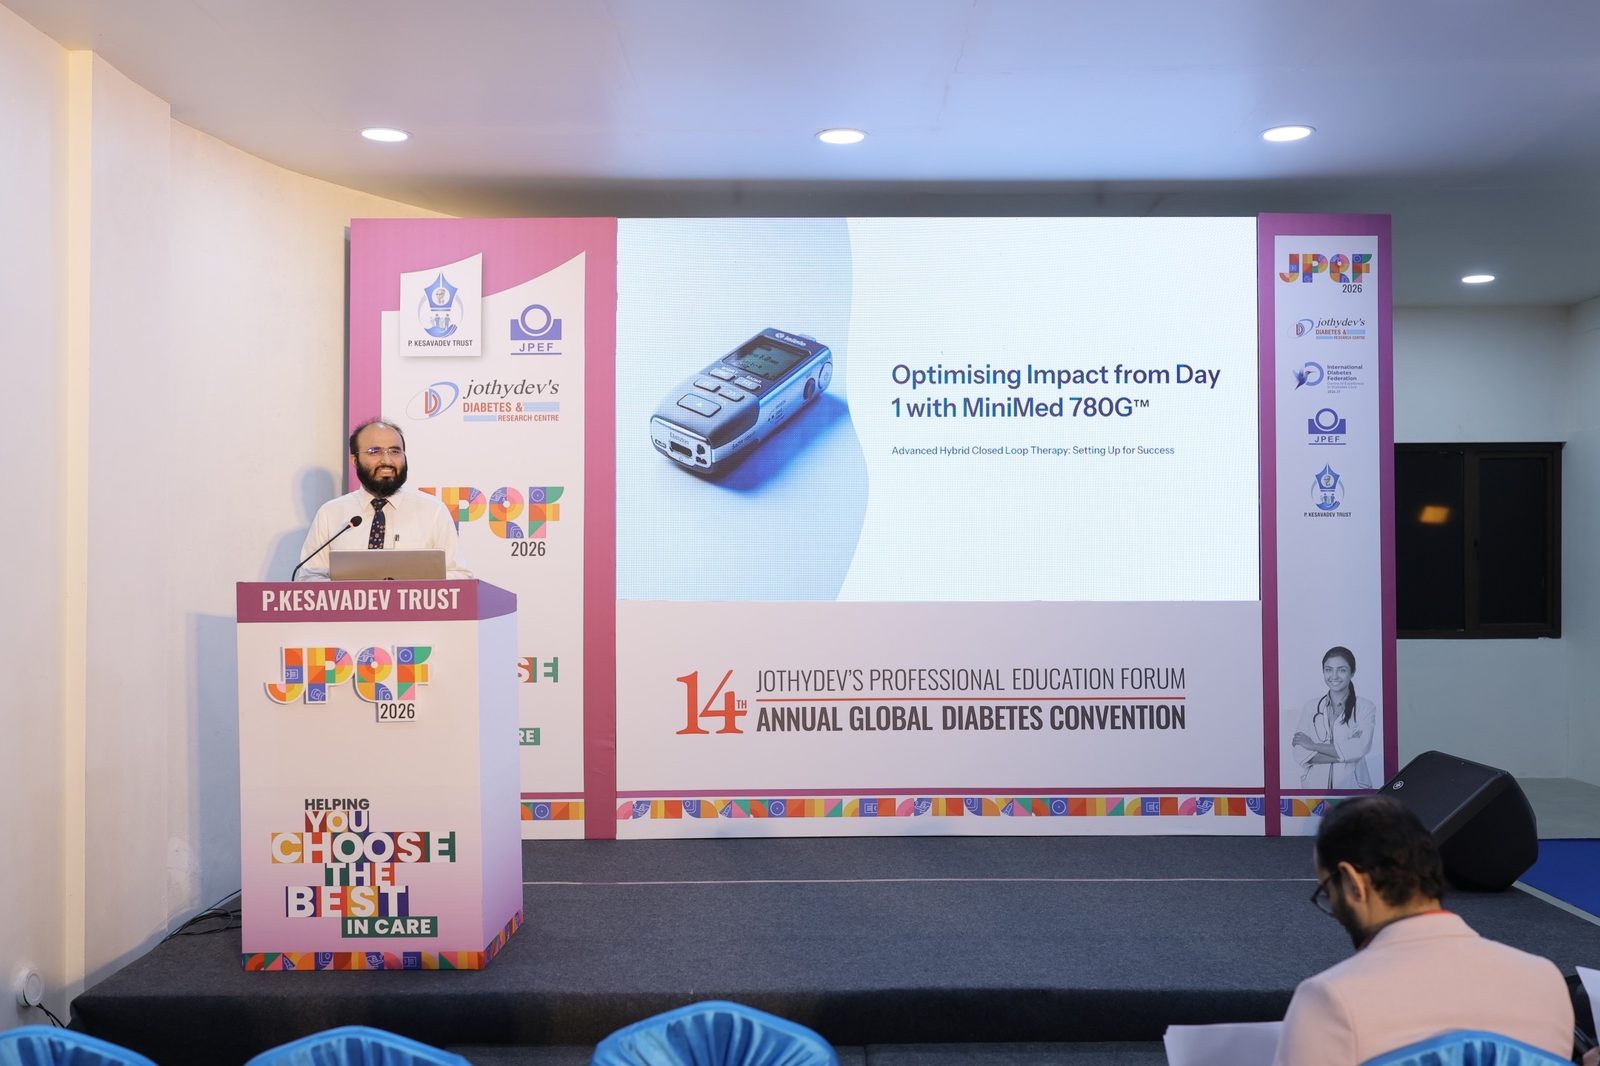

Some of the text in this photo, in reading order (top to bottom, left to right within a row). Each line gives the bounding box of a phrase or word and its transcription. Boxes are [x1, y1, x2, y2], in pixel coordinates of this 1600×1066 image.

[1342, 284, 1363, 293] 2026
[1315, 317, 1365, 329] jothydev's
[414, 339, 452, 347] KESAVADEV
[453, 339, 473, 347] TRUST
[519, 342, 554, 352] JPEF
[891, 364, 1221, 389] Optimising Impact from Day
[462, 379, 560, 399] jothydev's
[463, 402, 523, 413] DIABETES &
[891, 397, 902, 417] 1
[906, 397, 957, 417] with
[963, 397, 1064, 417] MiniMed
[497, 414, 560, 422] RESEARCH CENTRE
[1314, 435, 1341, 443] JPEF
[891, 446, 1175, 457] Advanced Hybrid Closed Loop Therapy: Setting Up for Success
[511, 541, 546, 557] 2026
[262, 587, 461, 612] P.KESAVADEV TRUST
[870, 668, 1005, 691] PROFESSIONAL
[1013, 667, 1114, 690] EDUCATION
[1121, 667, 1186, 690] FORUM
[380, 703, 415, 719] 2026
[757, 704, 1186, 732] ANNUAL GLOBAL DIABETES CONVENTION
[304, 798, 370, 811] HELPING
[305, 811, 369, 832] YOU
[271, 831, 453, 863] CHOOSE
[325, 863, 395, 886] THE
[287, 886, 407, 917] BEST
[347, 918, 431, 935] IN CARE
